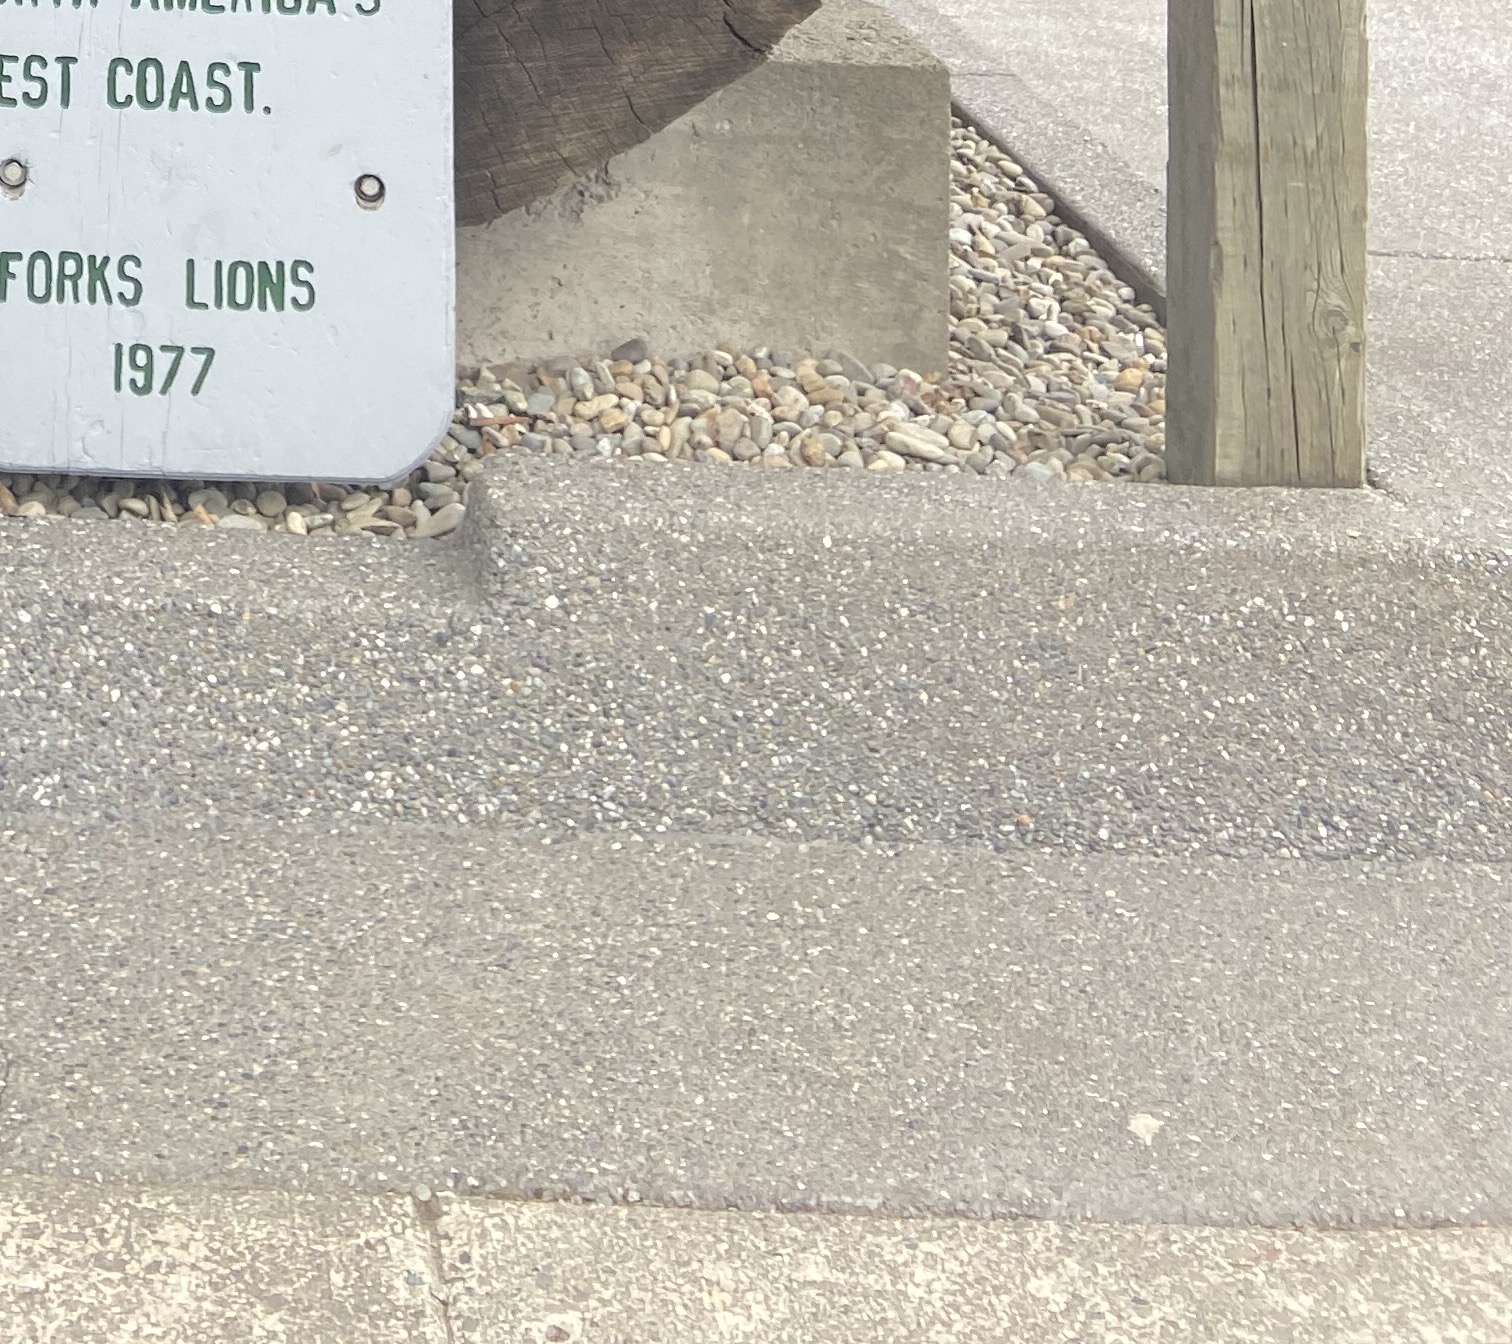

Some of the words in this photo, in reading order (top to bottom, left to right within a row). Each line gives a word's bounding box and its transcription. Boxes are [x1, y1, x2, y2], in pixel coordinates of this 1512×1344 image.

[106, 56, 272, 115] COAST.
[186, 258, 316, 313] LIONS
[113, 342, 216, 397] 1977
